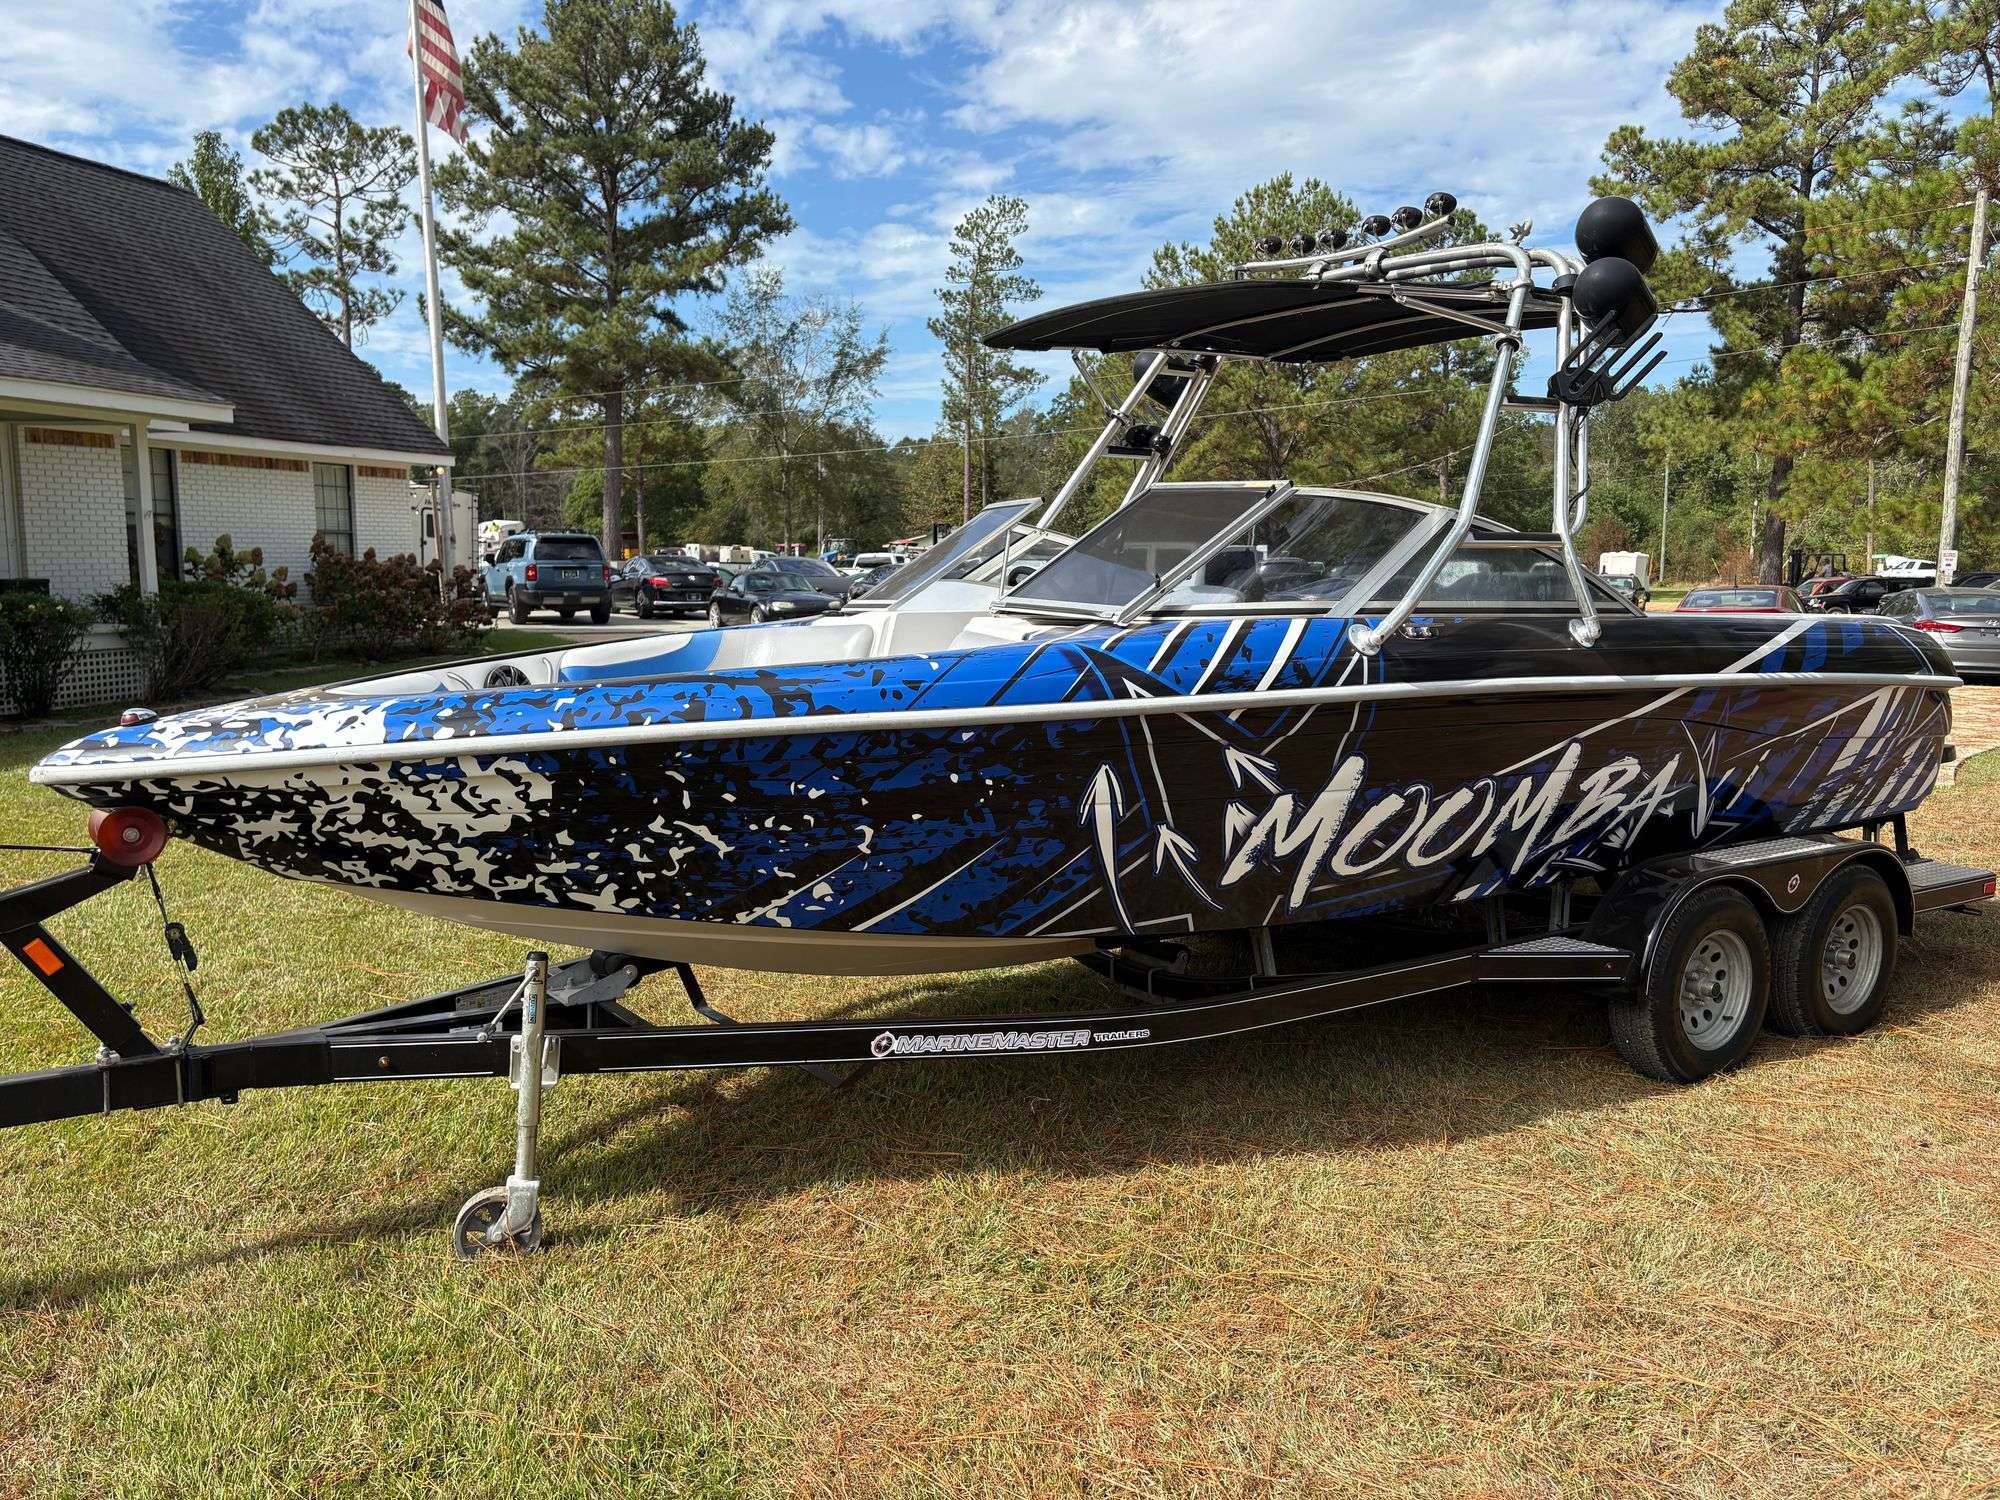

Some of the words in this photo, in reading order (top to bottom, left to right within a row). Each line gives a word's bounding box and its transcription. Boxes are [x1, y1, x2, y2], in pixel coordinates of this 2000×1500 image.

[1221, 742, 1689, 908] MOOMBA
[895, 1030, 1090, 1053] MARINEMASTER
[1094, 1029, 1149, 1041] TRAILERS
